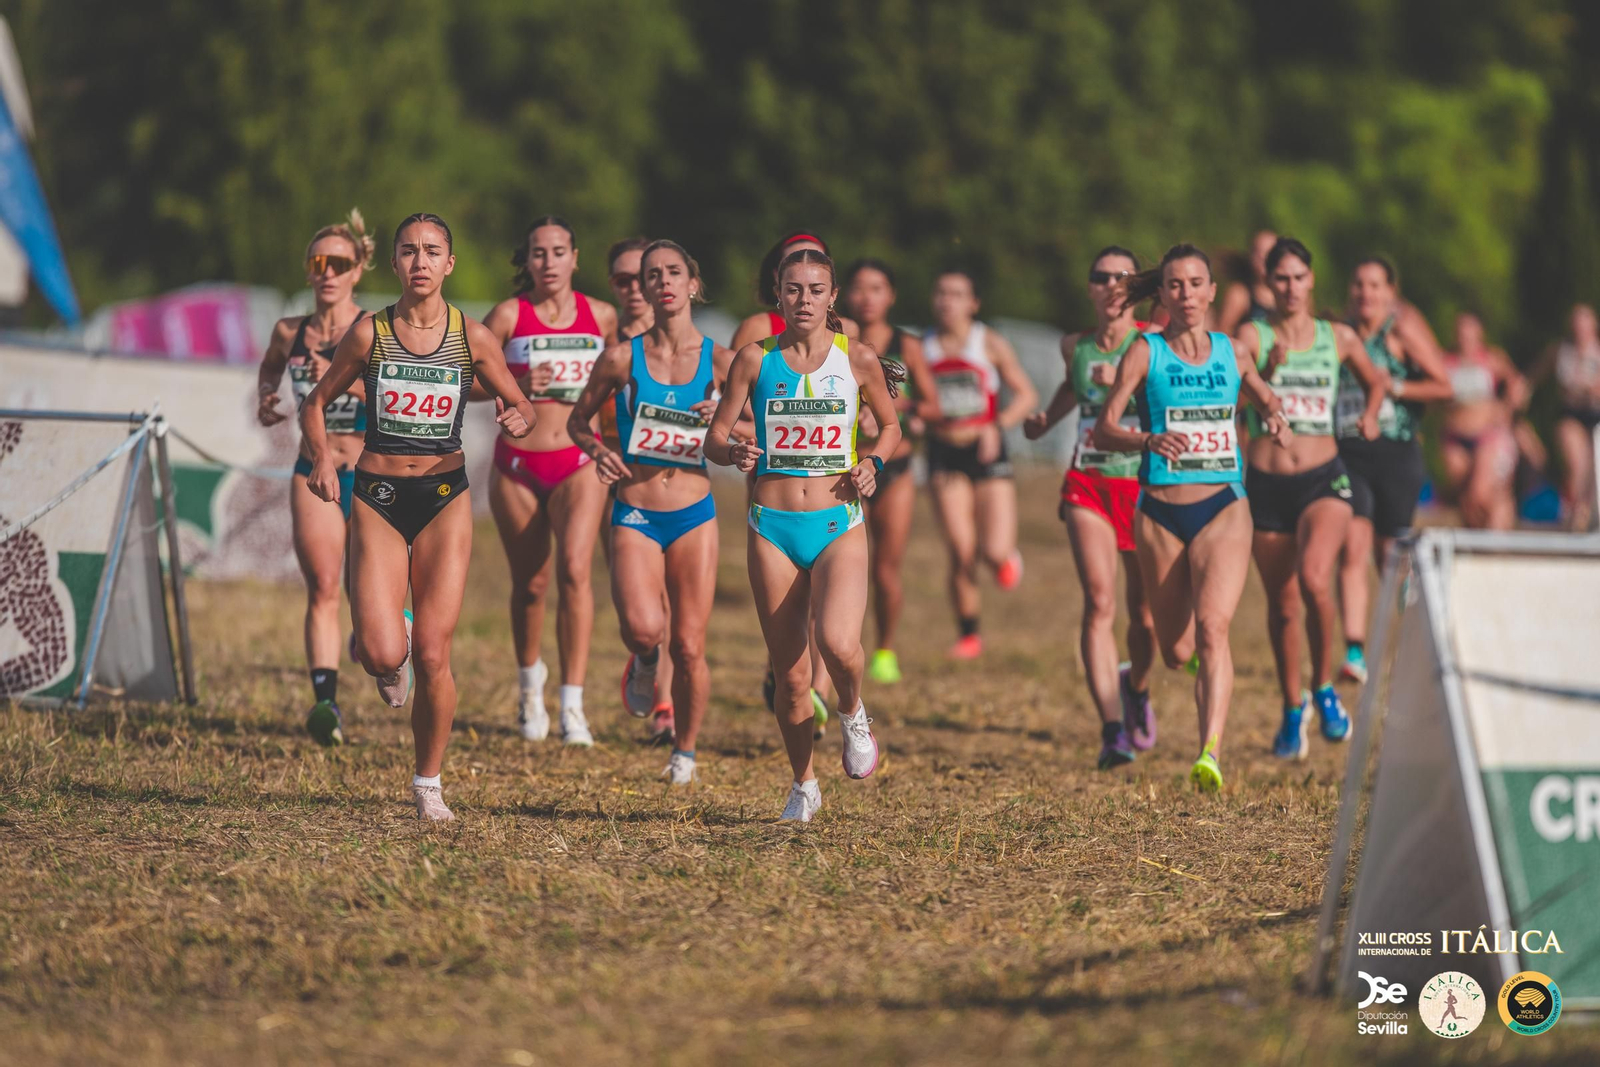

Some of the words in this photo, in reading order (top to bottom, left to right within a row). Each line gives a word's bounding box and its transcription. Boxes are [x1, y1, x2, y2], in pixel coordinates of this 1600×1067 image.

[402, 366, 441, 379] ITÁLICA
[1169, 370, 1228, 390] nerja
[384, 390, 453, 418] 2249
[788, 400, 828, 410] ITÁLICA
[637, 428, 701, 459] 2252
[774, 426, 841, 449] 2242
[1183, 431, 1231, 453] 251
